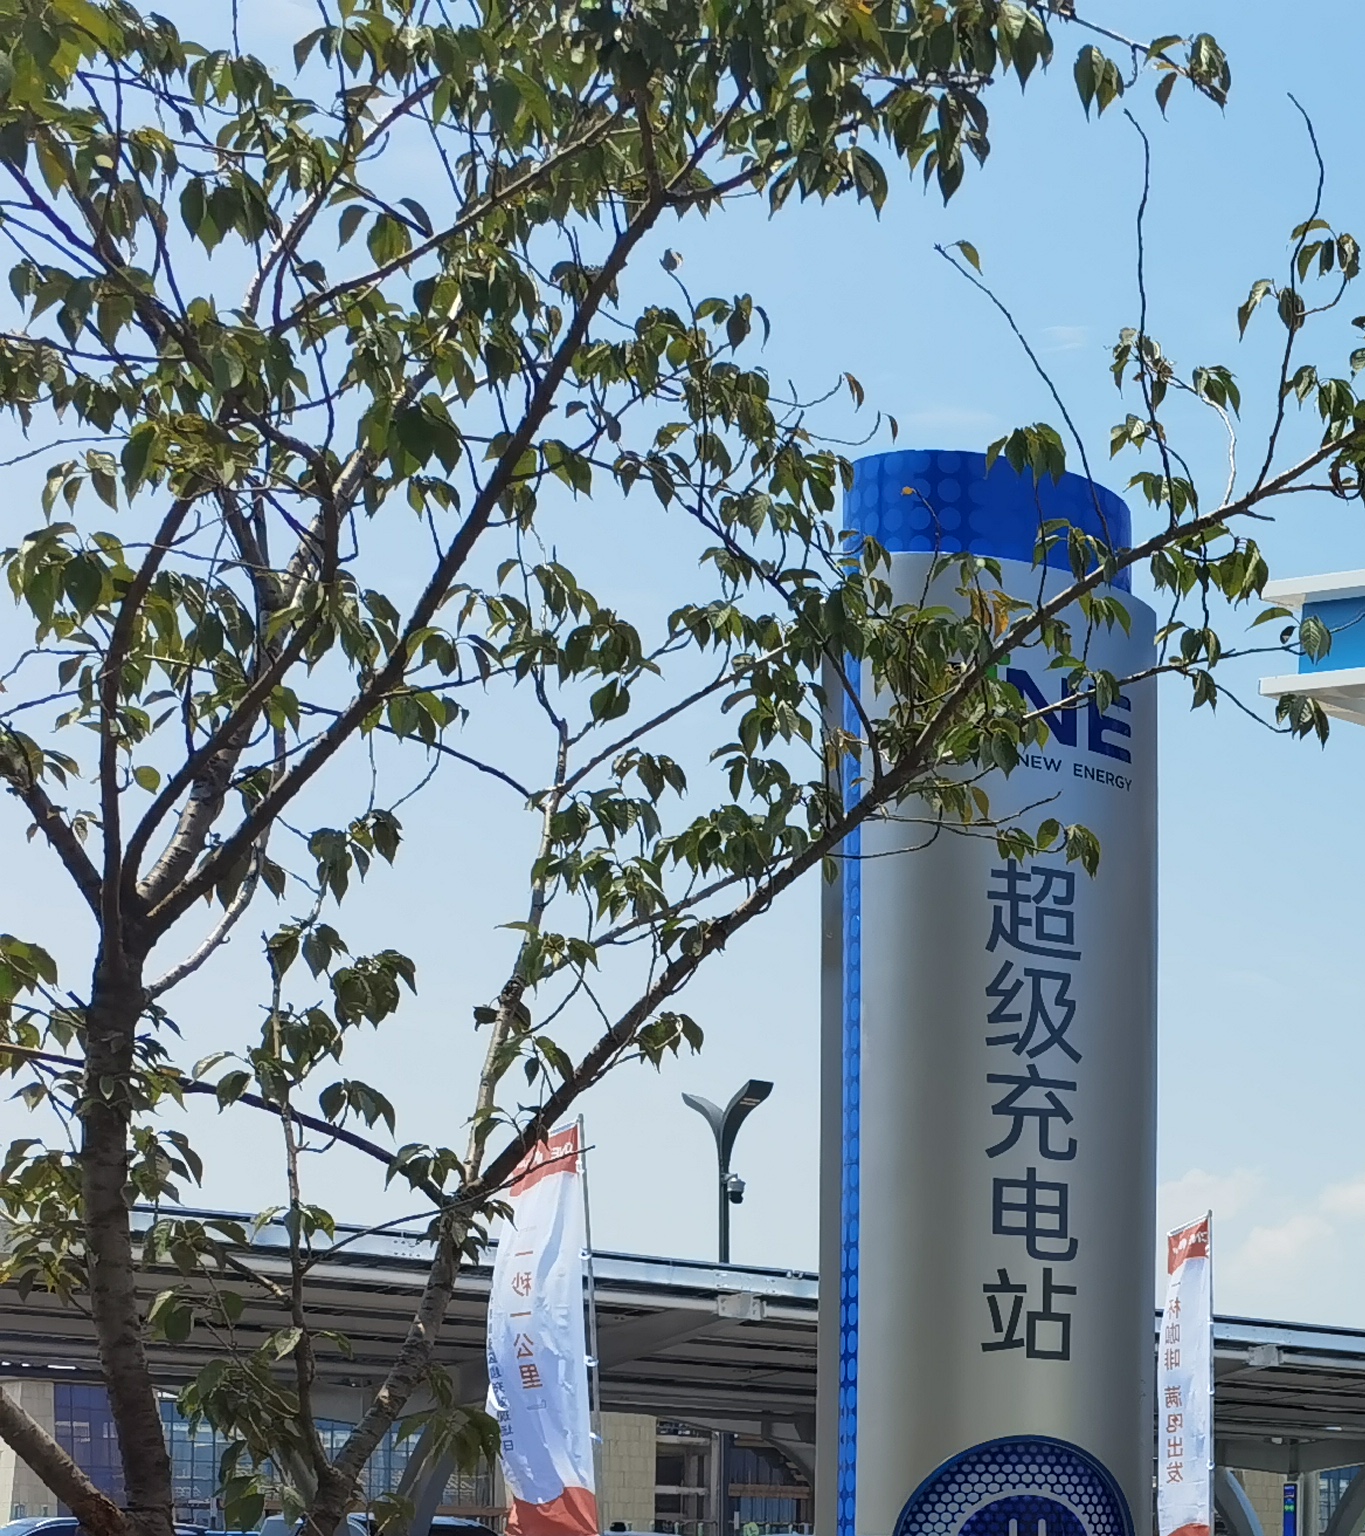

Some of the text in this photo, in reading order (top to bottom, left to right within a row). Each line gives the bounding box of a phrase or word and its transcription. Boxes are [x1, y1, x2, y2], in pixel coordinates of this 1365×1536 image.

[1006, 667, 1132, 764] NE
[1018, 752, 1133, 792] NEW ENERGY
[981, 857, 1083, 1362] 超级充电站
